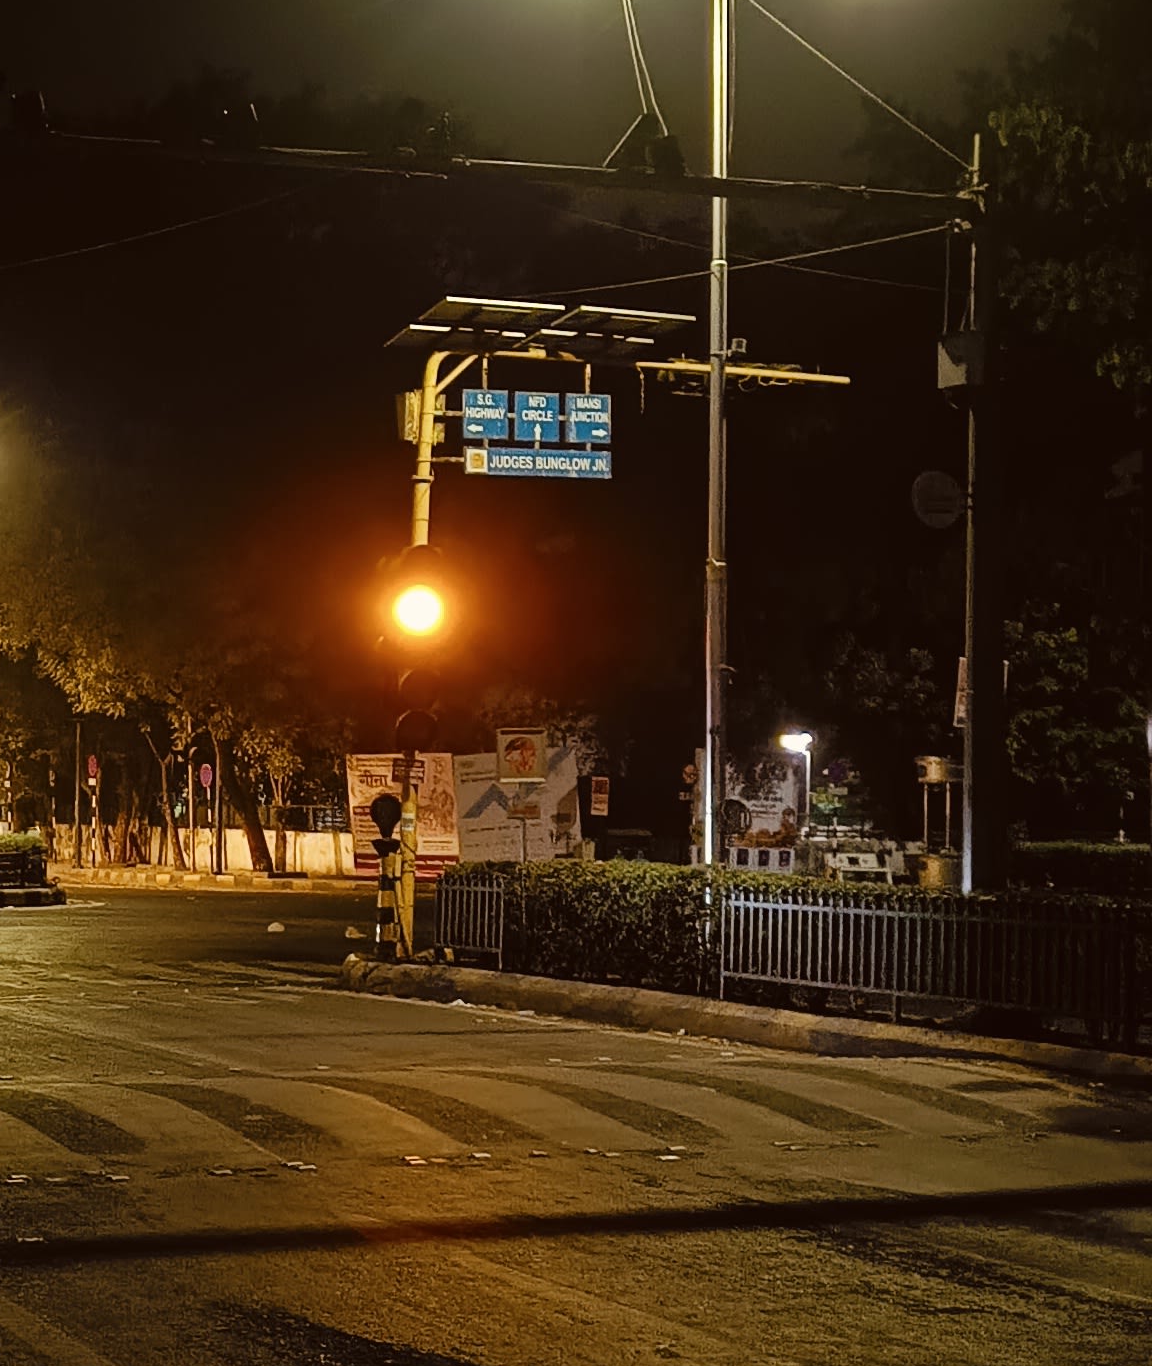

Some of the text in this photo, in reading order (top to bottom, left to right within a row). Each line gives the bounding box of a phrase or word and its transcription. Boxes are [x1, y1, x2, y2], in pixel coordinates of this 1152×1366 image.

[477, 393, 495, 405] S.G.
[528, 396, 546, 408] NFD
[576, 397, 601, 409] MANSI
[465, 407, 505, 420] HIGHWAY
[521, 410, 553, 422] CIRCLE
[570, 411, 609, 423] JUNCTION
[489, 455, 609, 471] JUDGES BUNGLOW JN.
